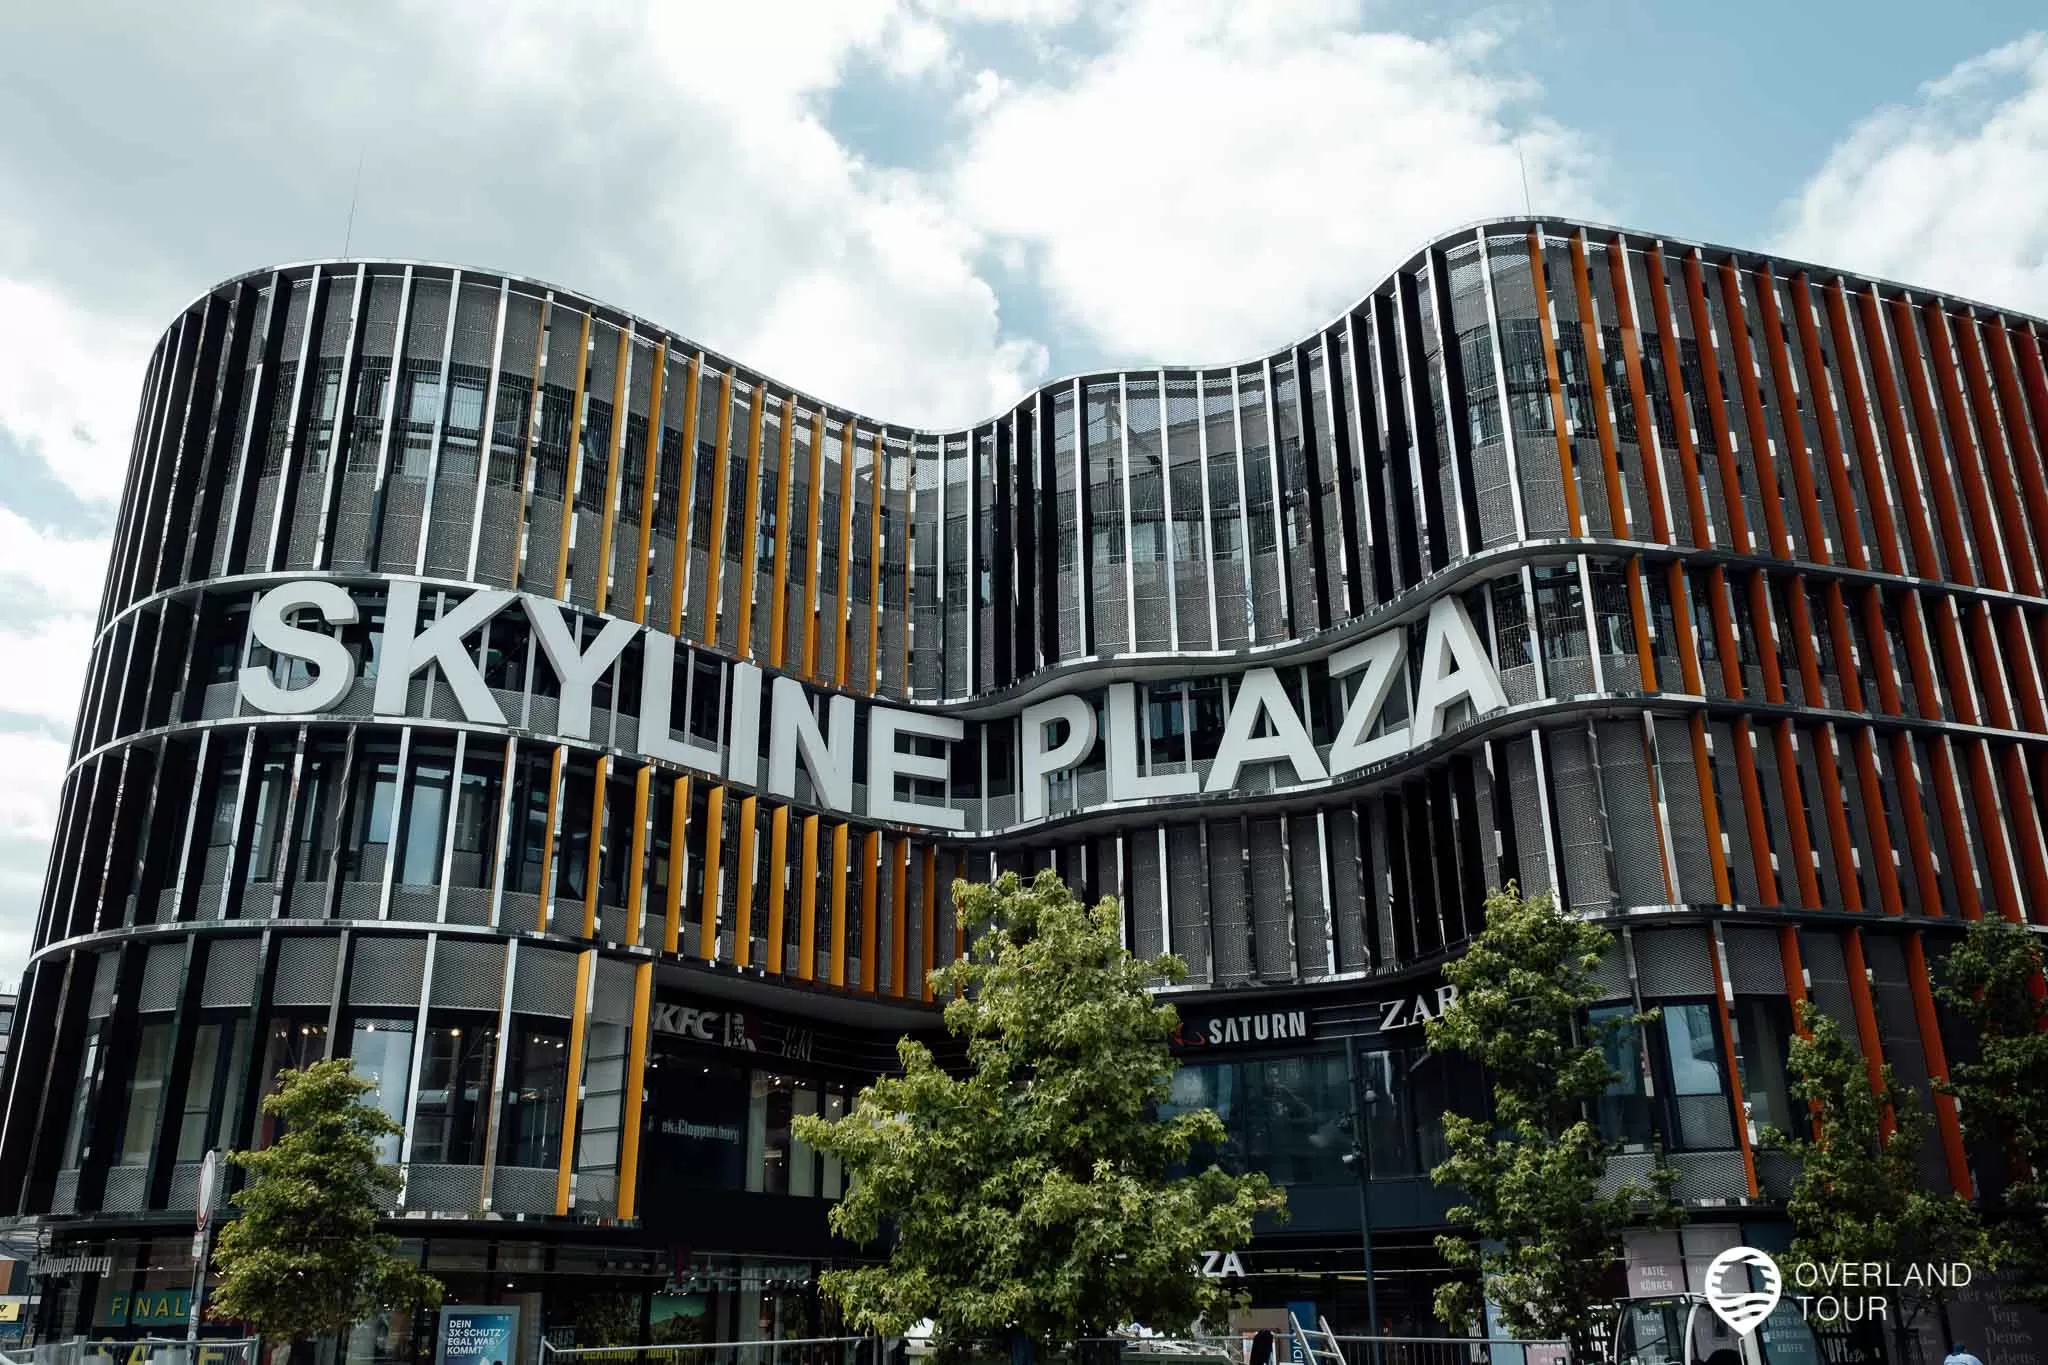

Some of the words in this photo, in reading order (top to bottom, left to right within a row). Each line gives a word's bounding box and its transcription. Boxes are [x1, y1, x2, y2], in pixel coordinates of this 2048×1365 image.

[237, 580, 967, 830] SKYLINE
[1021, 596, 1510, 822] PLAZA
[654, 1002, 721, 1040] KFC
[1378, 985, 1459, 1031] ZAR
[1208, 1011, 1306, 1045] SATURN
[111, 1296, 186, 1318] FINAL
[449, 1319, 472, 1329] DEIN
[446, 1346, 483, 1355] KOMMT
[447, 1337, 472, 1346] EGAL
[474, 1337, 496, 1346] WAS
